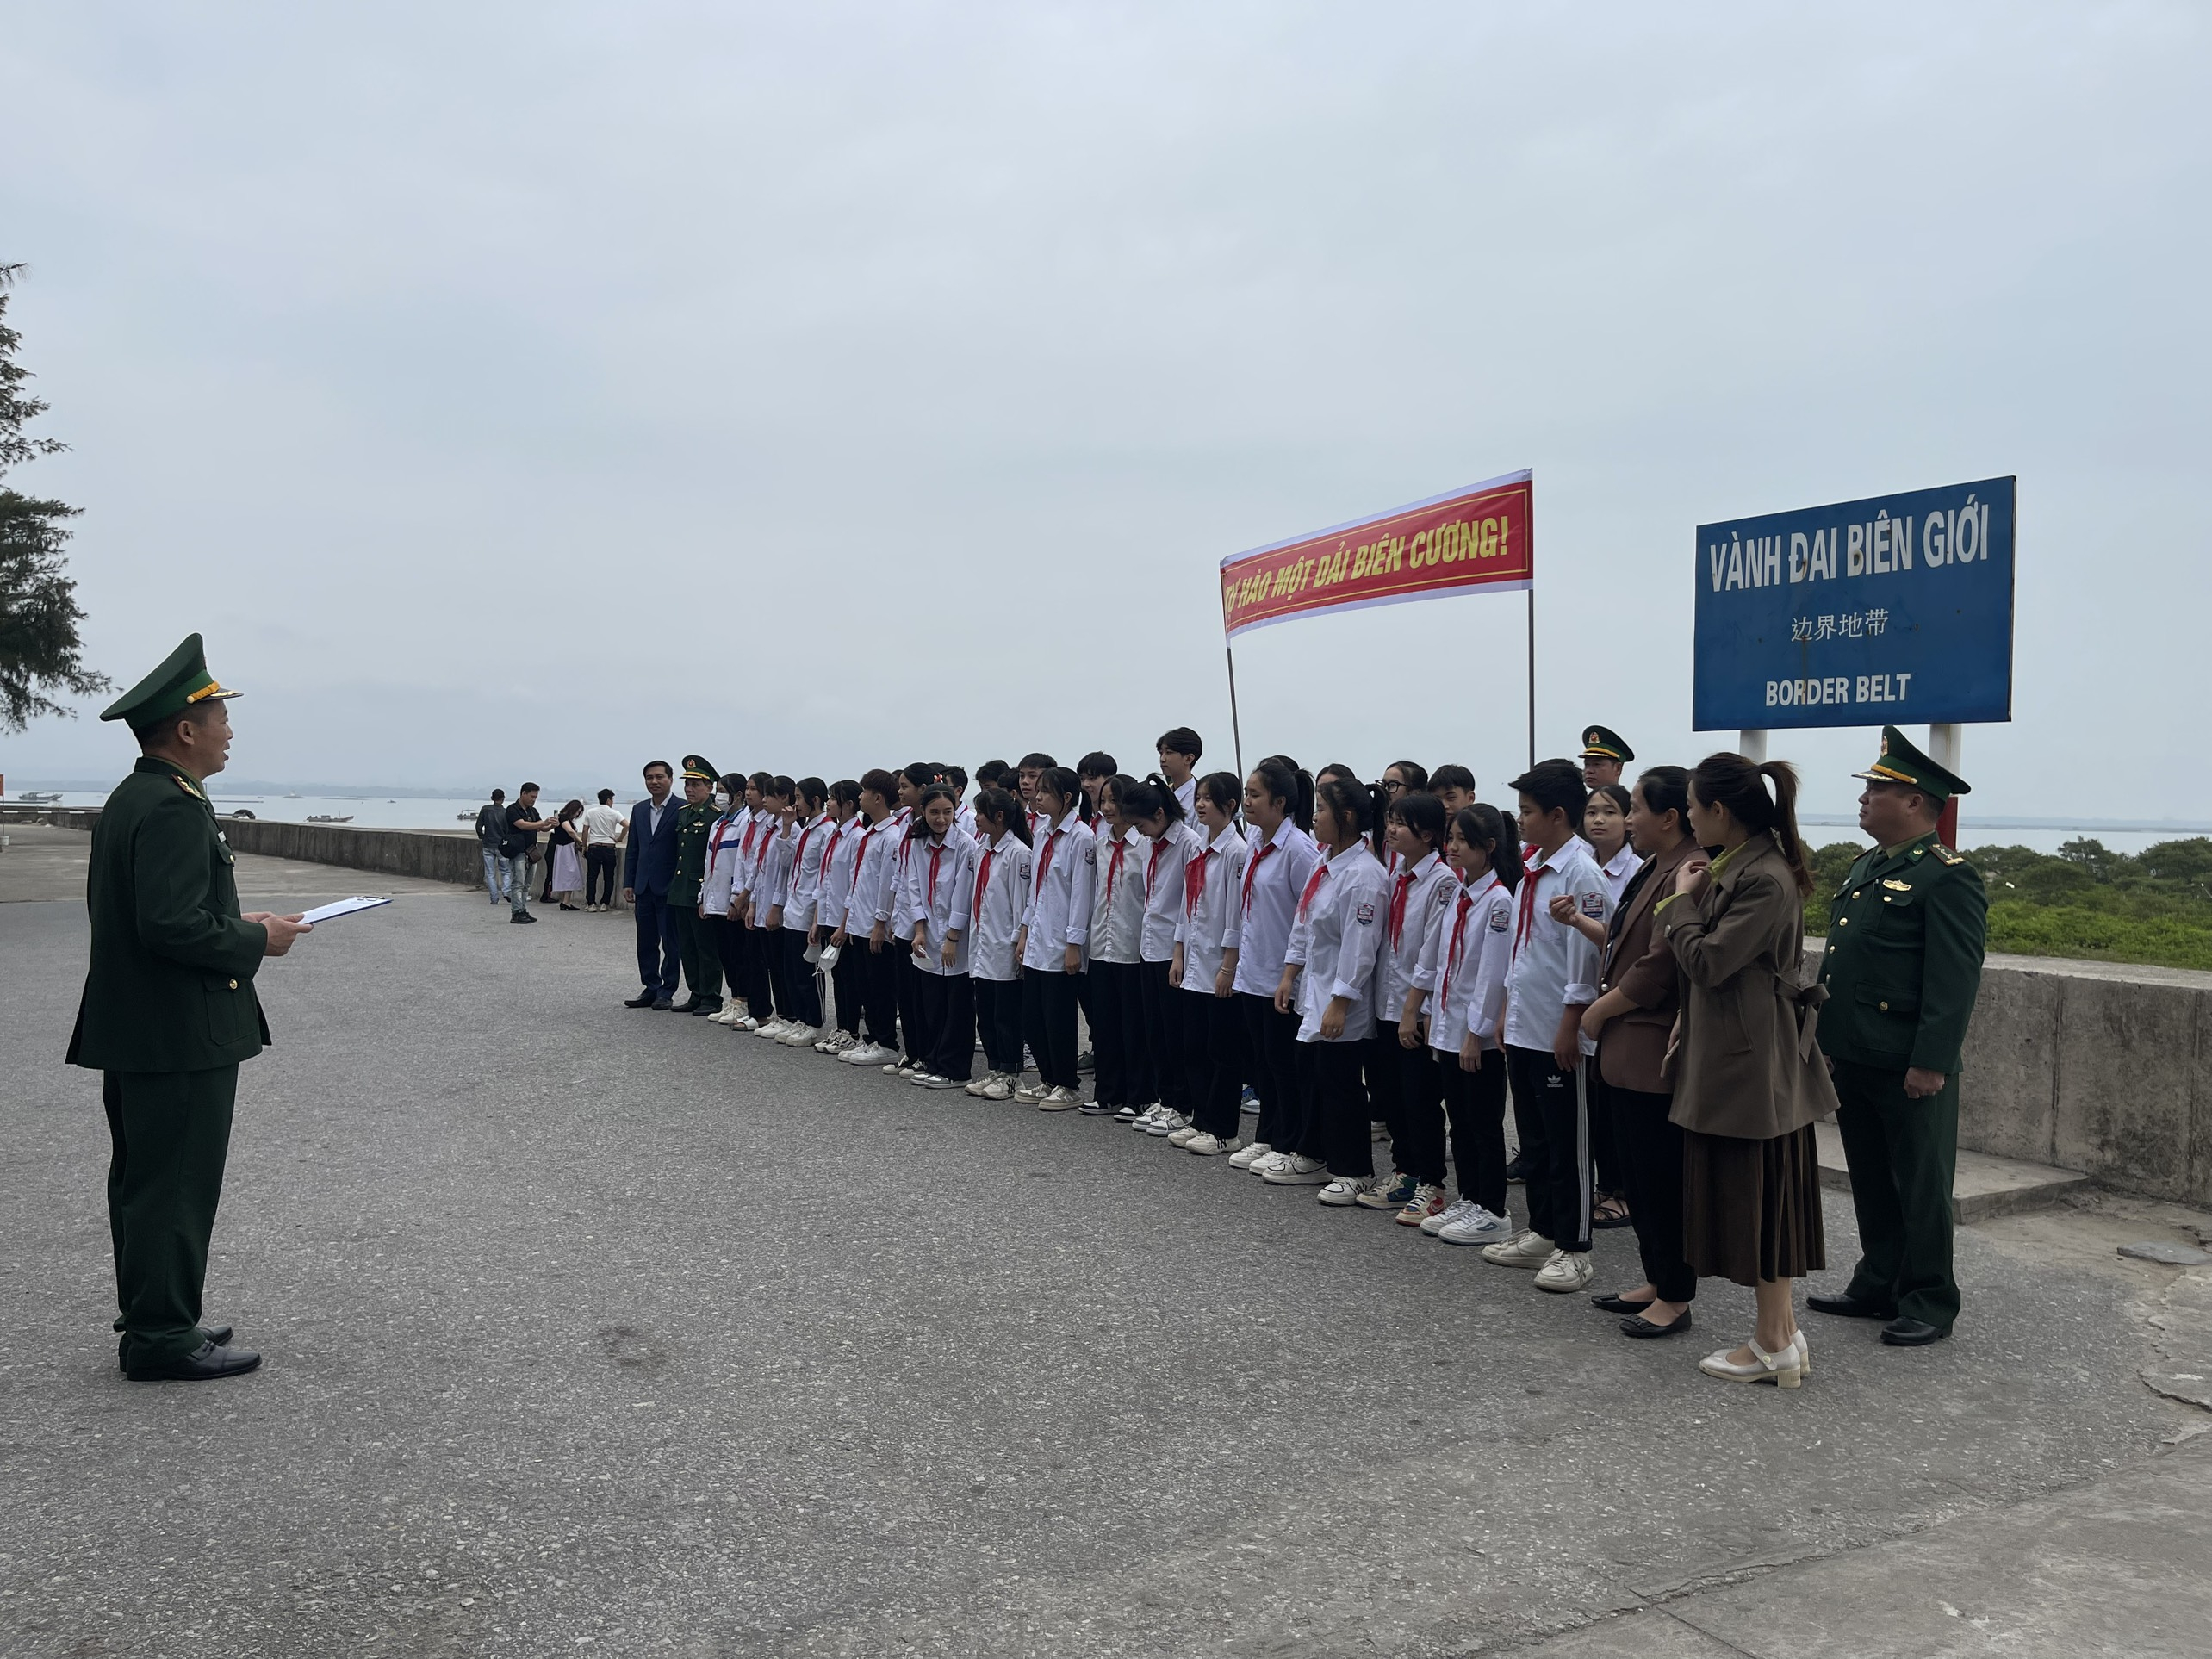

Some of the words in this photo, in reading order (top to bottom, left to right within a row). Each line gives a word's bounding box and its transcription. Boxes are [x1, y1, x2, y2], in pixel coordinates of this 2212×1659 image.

[1238, 569, 1272, 609] HÀO
[1271, 556, 1316, 601] MỘT
[1352, 533, 1407, 578] BIÊN
[1410, 516, 1507, 569] CƯƠNG!
[1710, 531, 1781, 593] VÀNH
[1788, 527, 1837, 584] ĐAI
[1847, 509, 1913, 576] BIÊN
[1923, 494, 1989, 569] GIỚI
[1791, 607, 1889, 642] 边界地带
[1766, 678, 1849, 706] BORDER
[1855, 674, 1911, 703] BELT
